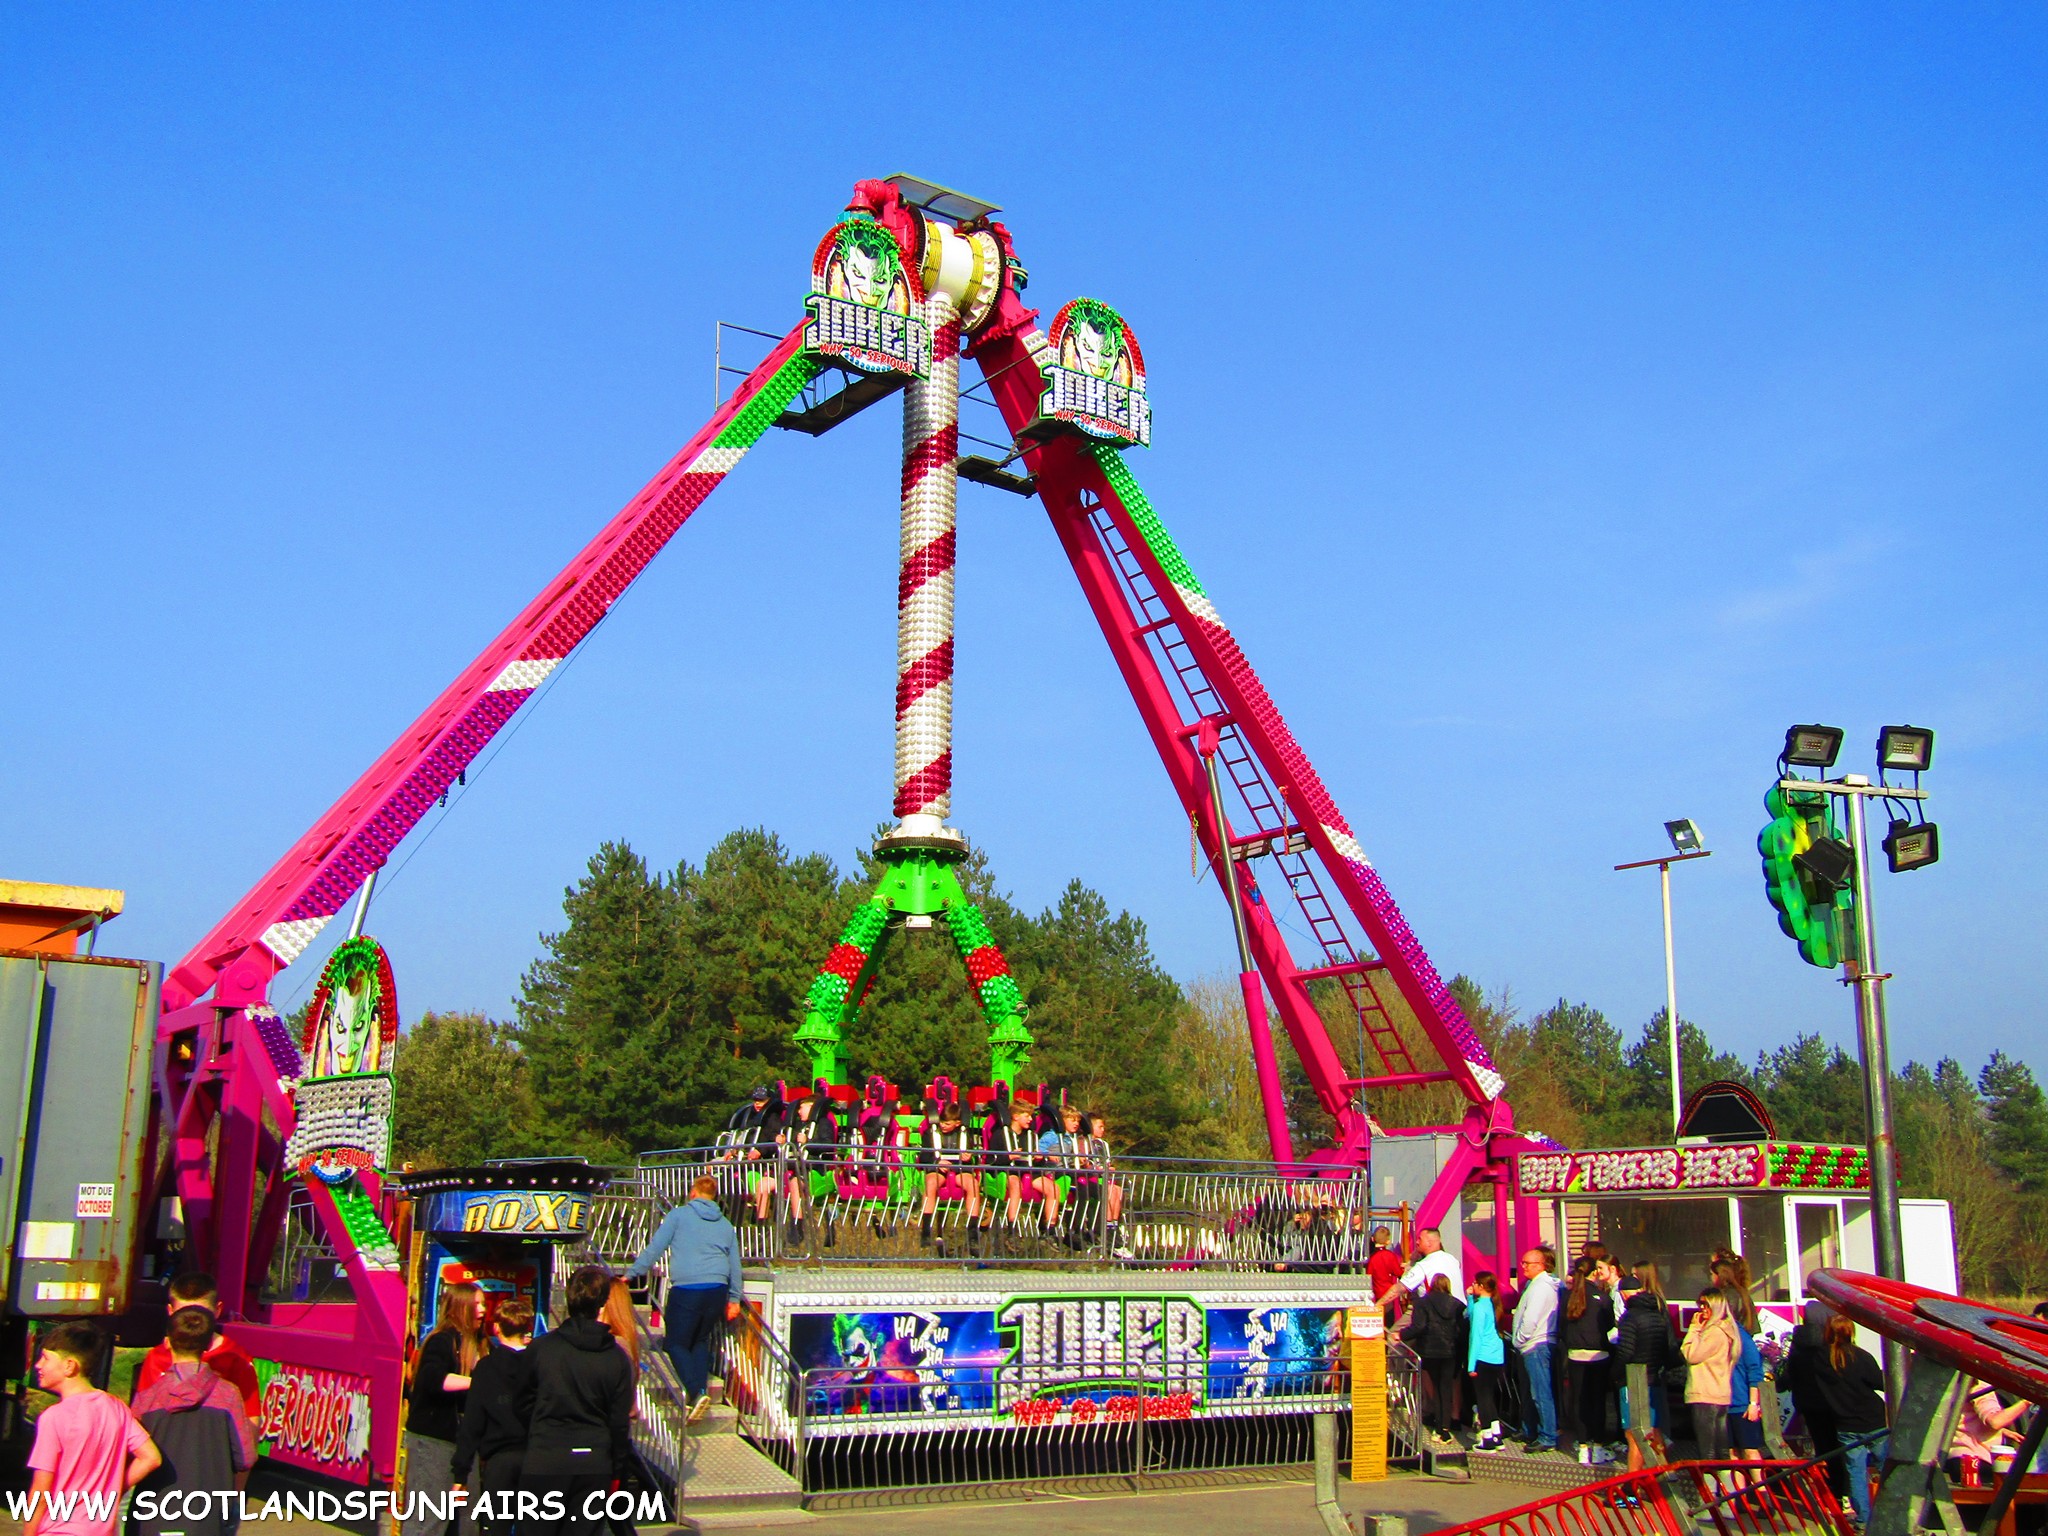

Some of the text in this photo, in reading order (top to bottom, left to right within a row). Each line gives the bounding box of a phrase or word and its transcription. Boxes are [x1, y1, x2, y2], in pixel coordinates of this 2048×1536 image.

[805, 295, 930, 377] JOKER
[820, 343, 914, 376] WHY SO SERIOUS!
[1042, 366, 1150, 445] JOKER
[1054, 410, 1136, 443] WHY SO SERIOUS!
[1521, 1146, 1758, 1191] BUY TOKENS HERE
[81, 1186, 113, 1196] MOT DUE
[78, 1200, 112, 1213] OCTOBER
[463, 1194, 589, 1233] BOXE
[894, 1316, 916, 1341] HA
[1244, 1323, 1257, 1338] HA
[1269, 1312, 1288, 1332] HA
[910, 1338, 925, 1354] HA
[933, 1327, 949, 1344] HA
[1264, 1331, 1276, 1346] HA
[926, 1347, 944, 1367] HA
[1000, 1301, 1203, 1412] JOKER
[1248, 1341, 1263, 1359] HA
[258, 1374, 352, 1463] SERIOUS!
